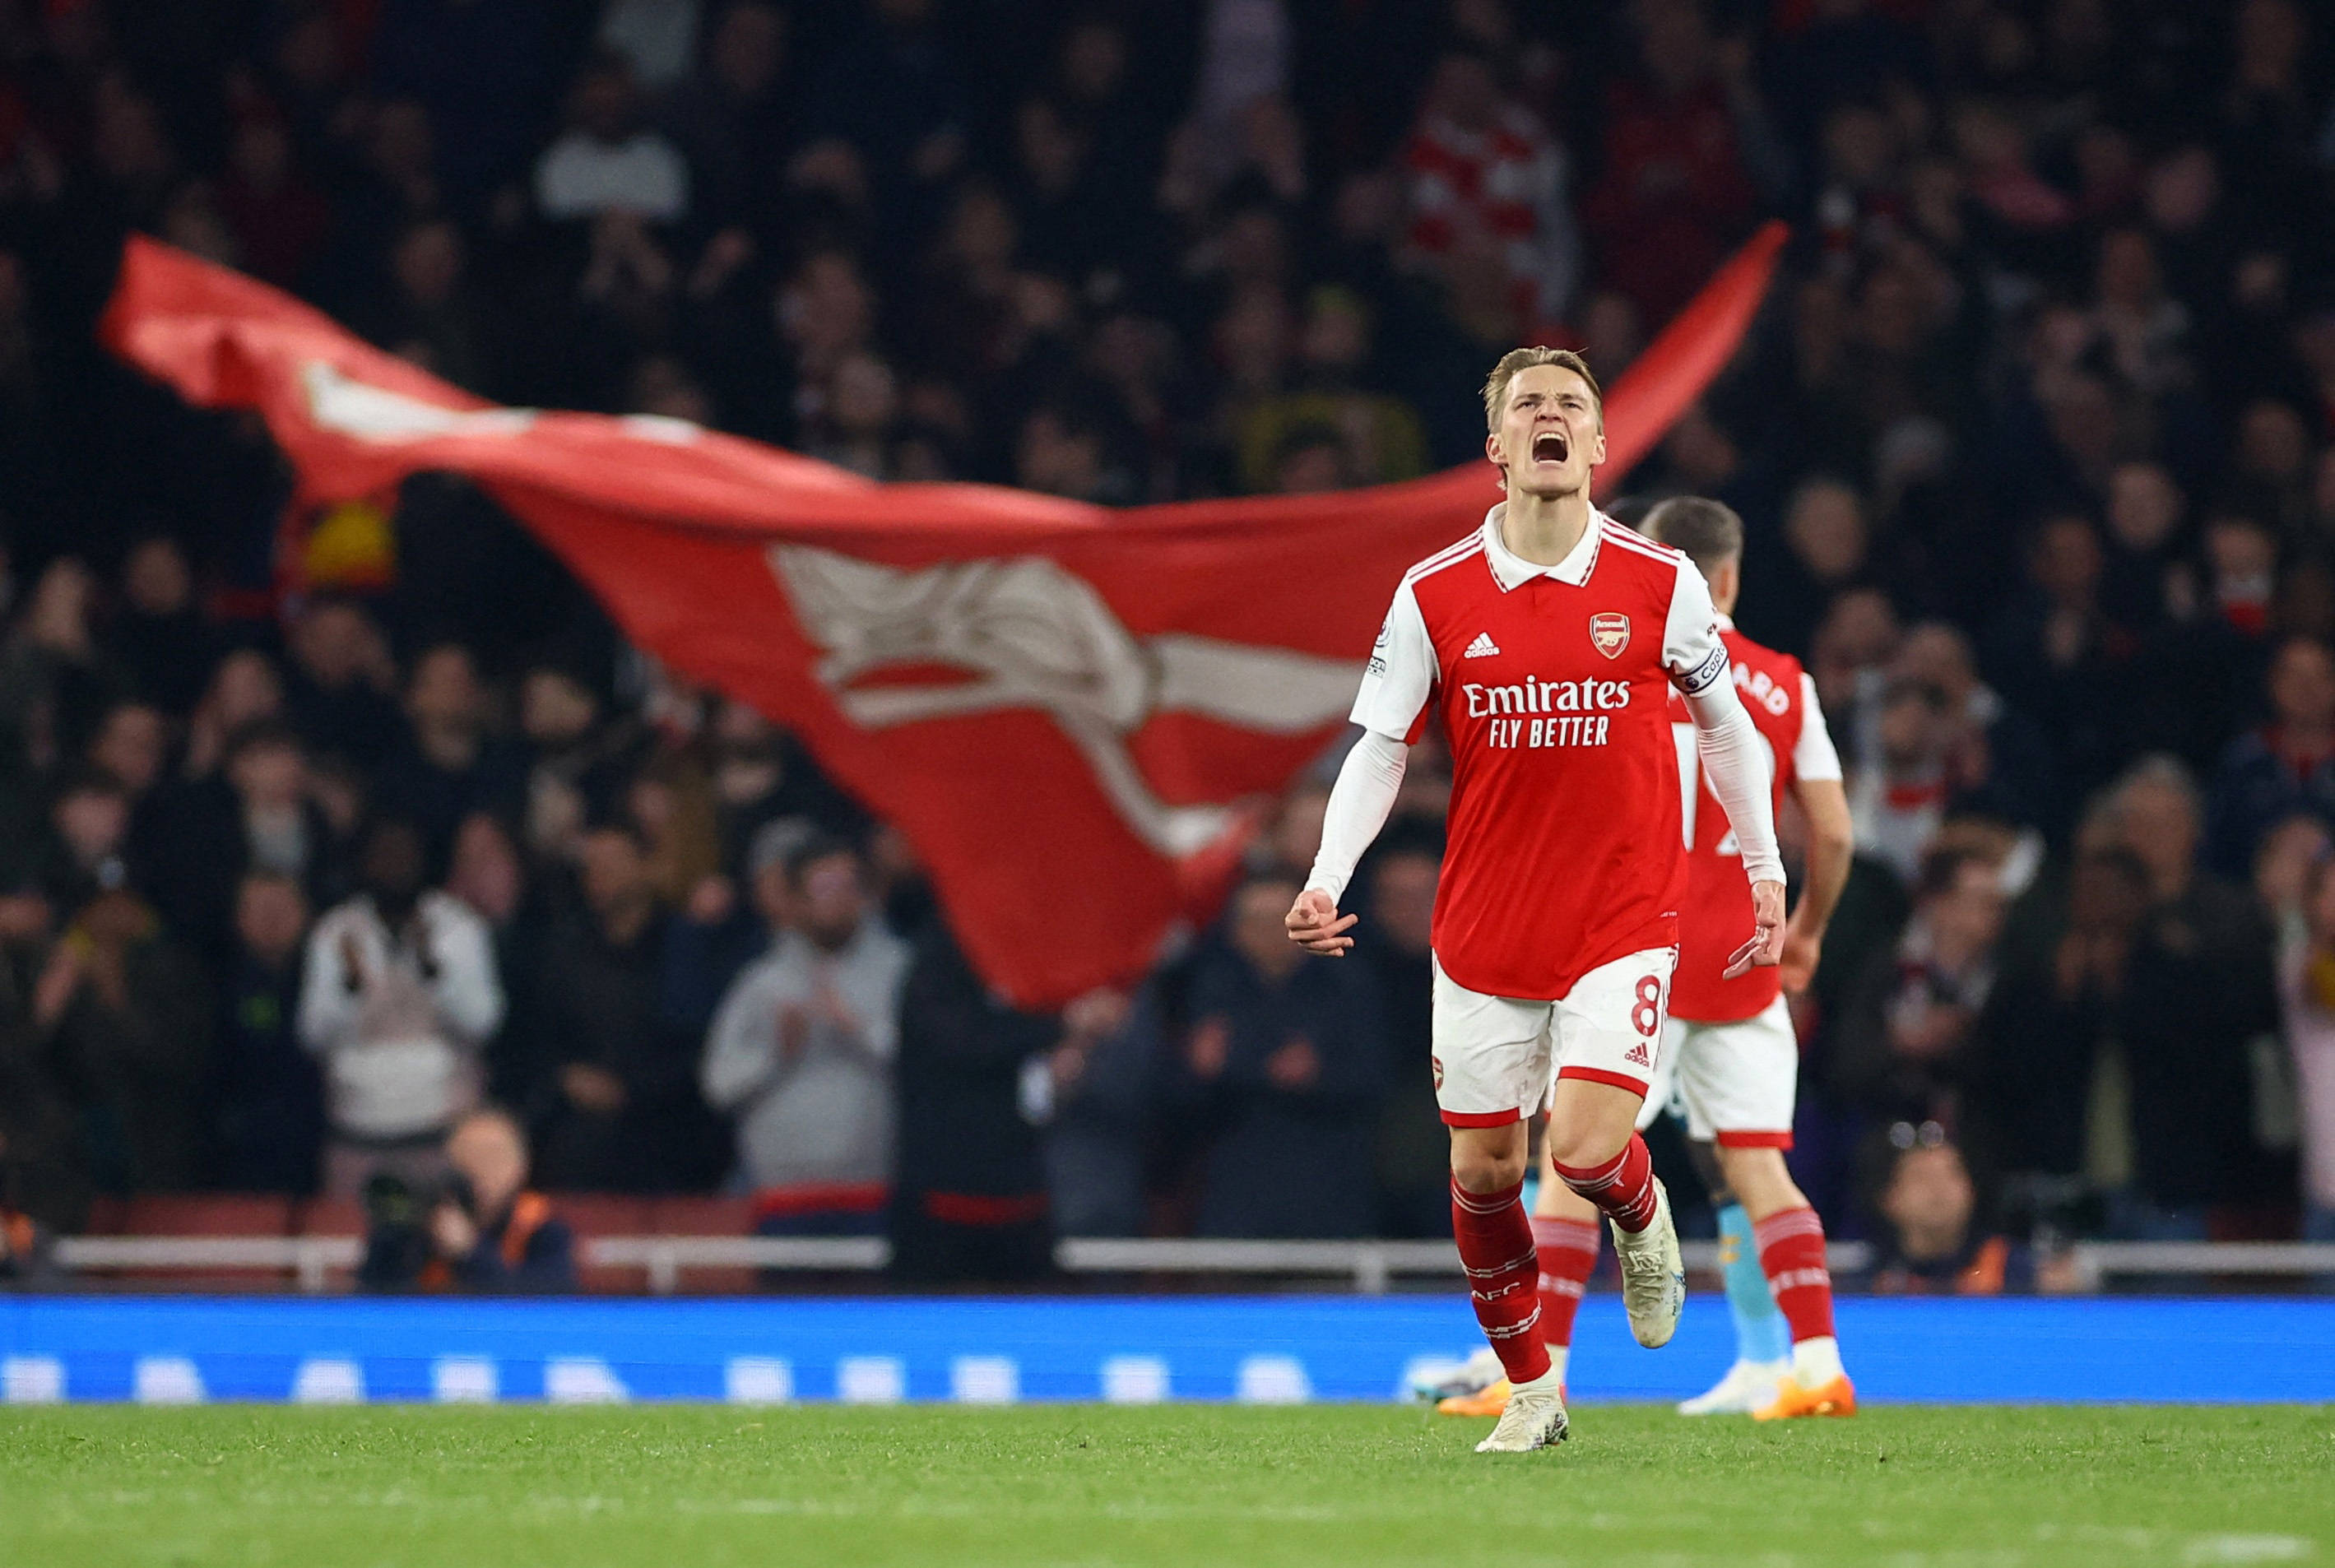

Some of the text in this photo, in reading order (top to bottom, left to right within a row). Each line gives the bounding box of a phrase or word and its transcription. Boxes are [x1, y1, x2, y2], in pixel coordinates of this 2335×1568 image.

[1465, 645, 1500, 658] adidas
[1462, 675, 1631, 717] Emirates
[1732, 661, 1790, 717] ARD
[1489, 716, 1609, 749] FLY BETTER
[1631, 975, 1660, 1037] 8
[1471, 1282, 1520, 1301] AFC
